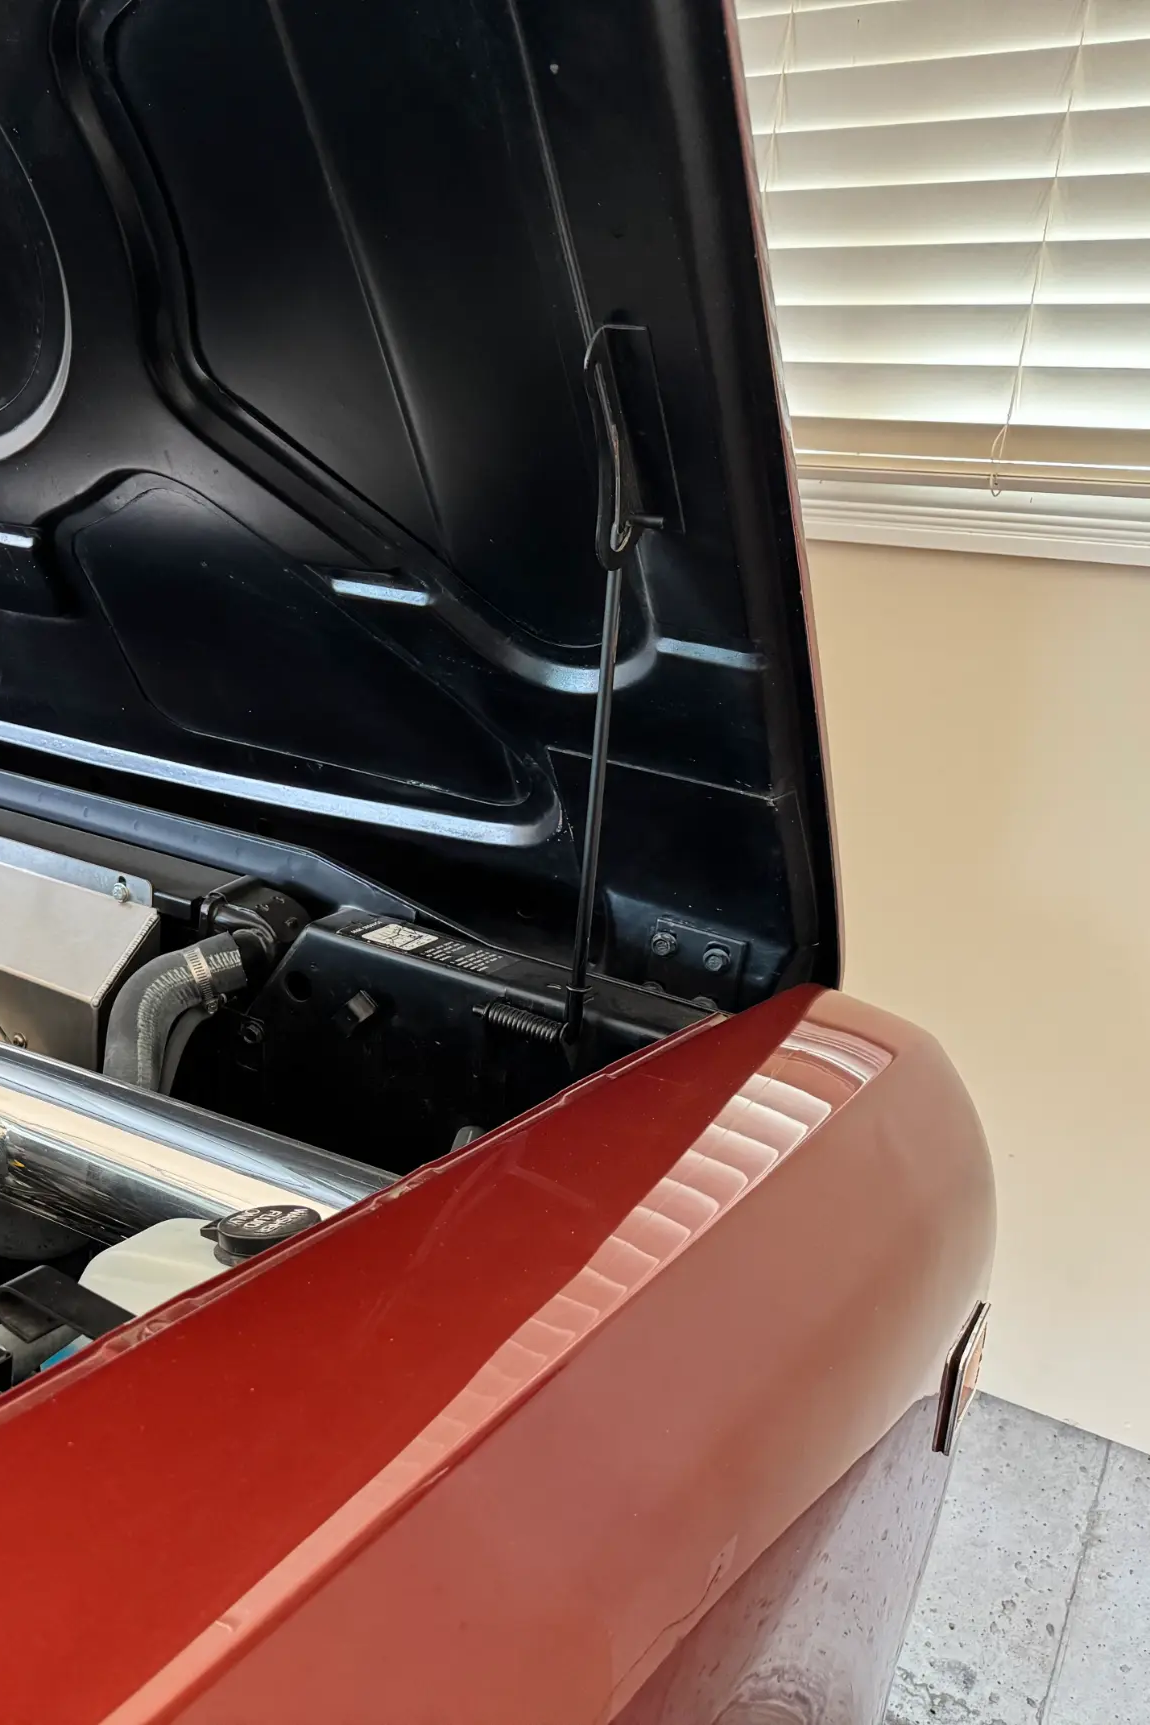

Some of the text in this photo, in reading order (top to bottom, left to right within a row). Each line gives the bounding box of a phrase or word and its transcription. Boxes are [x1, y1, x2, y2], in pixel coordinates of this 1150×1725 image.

[227, 1208, 260, 1226] ONLY
[244, 1209, 283, 1230] FLUID
[254, 1208, 308, 1234] WASHER
